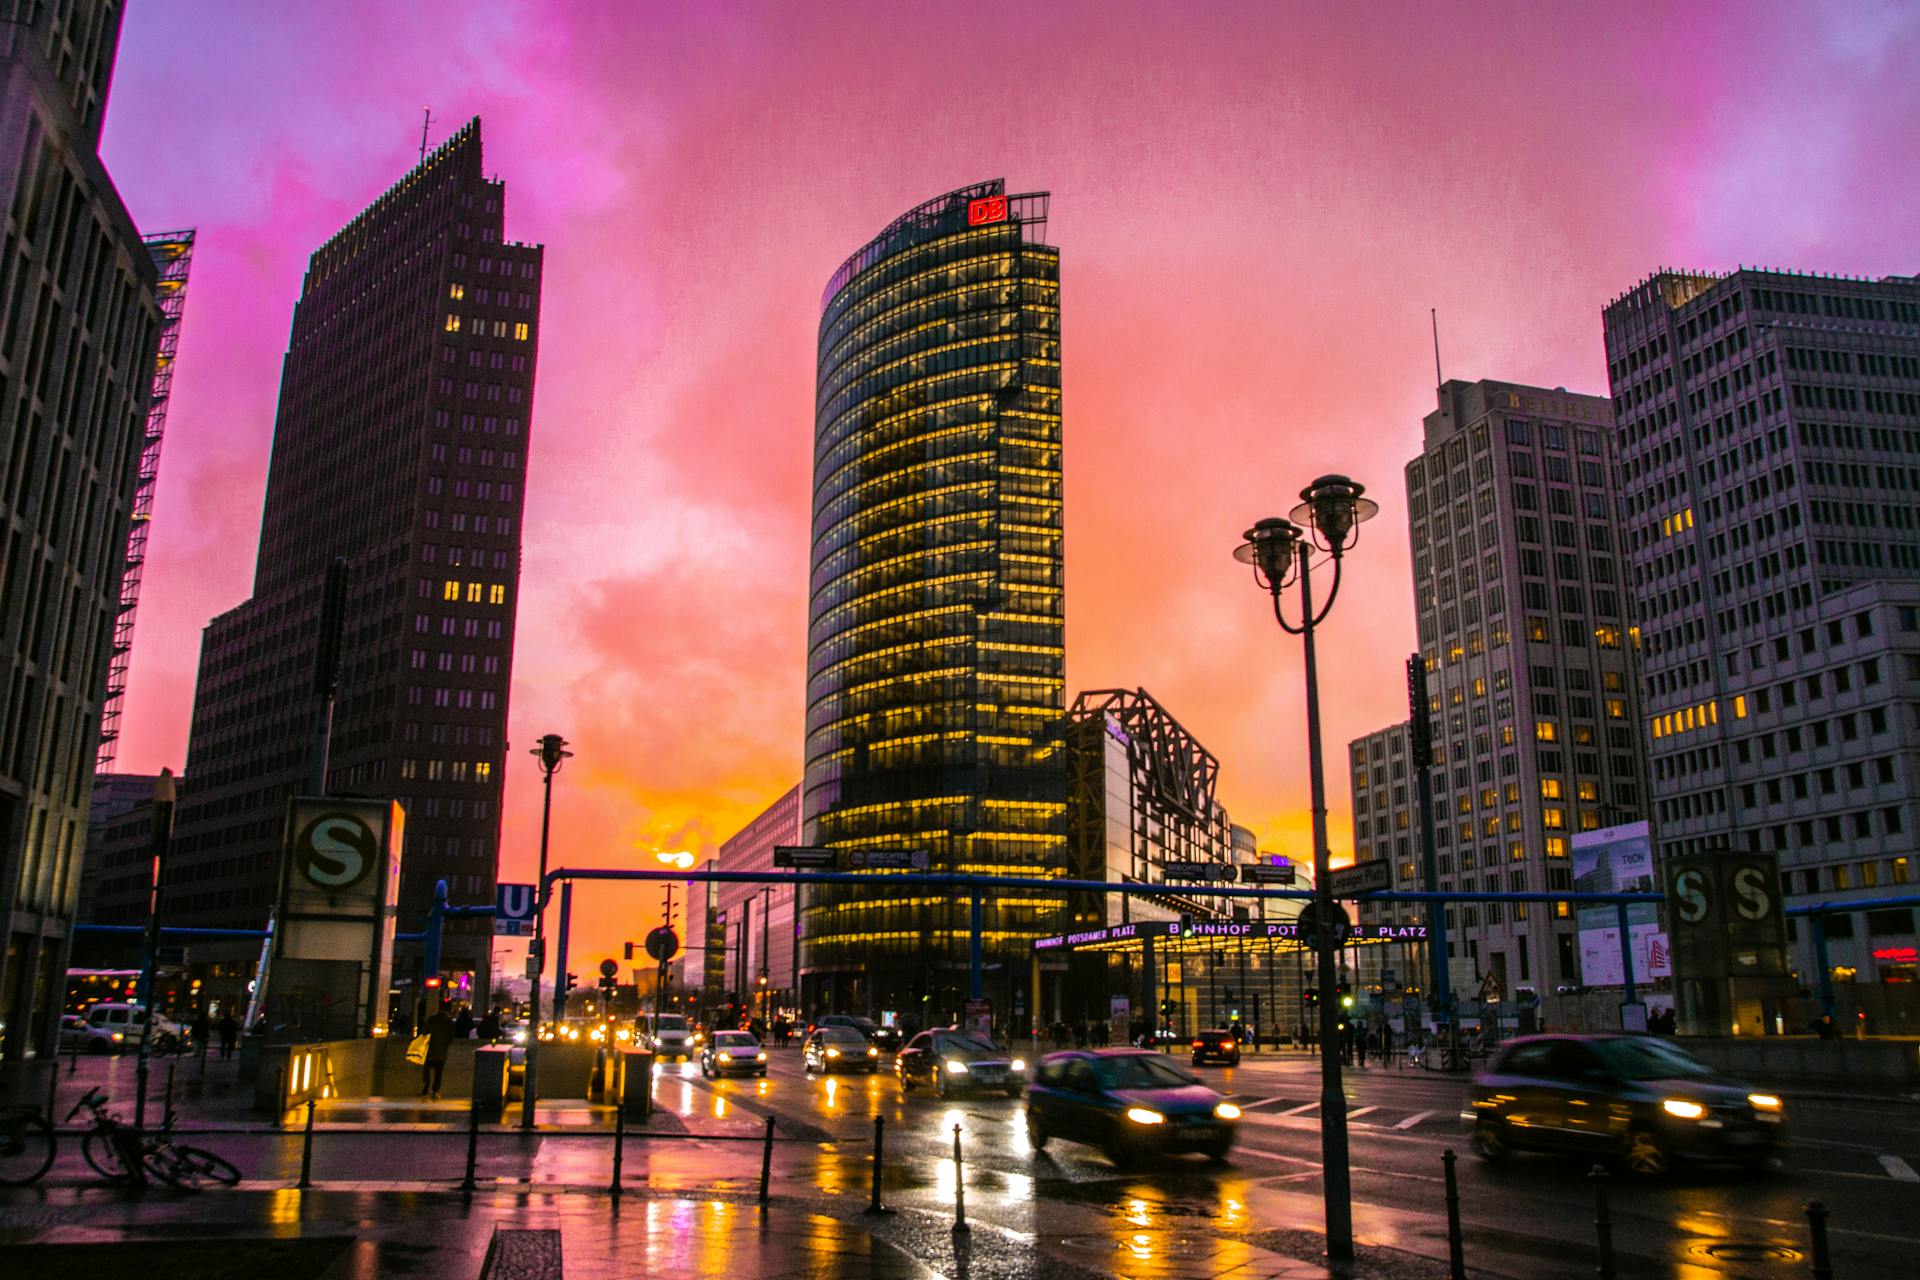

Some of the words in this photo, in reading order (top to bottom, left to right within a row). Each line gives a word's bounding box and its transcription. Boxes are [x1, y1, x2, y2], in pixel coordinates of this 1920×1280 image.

[972, 199, 1004, 222] DB
[308, 818, 363, 886] S
[503, 885, 530, 917] U
[1676, 870, 1707, 922] S
[1734, 867, 1770, 920] S
[1068, 929, 1107, 944] POTSDAMER
[1112, 924, 1136, 938] PLATZ
[1169, 923, 1252, 935] BHNHOF
[1379, 926, 1427, 937] PLATZ
